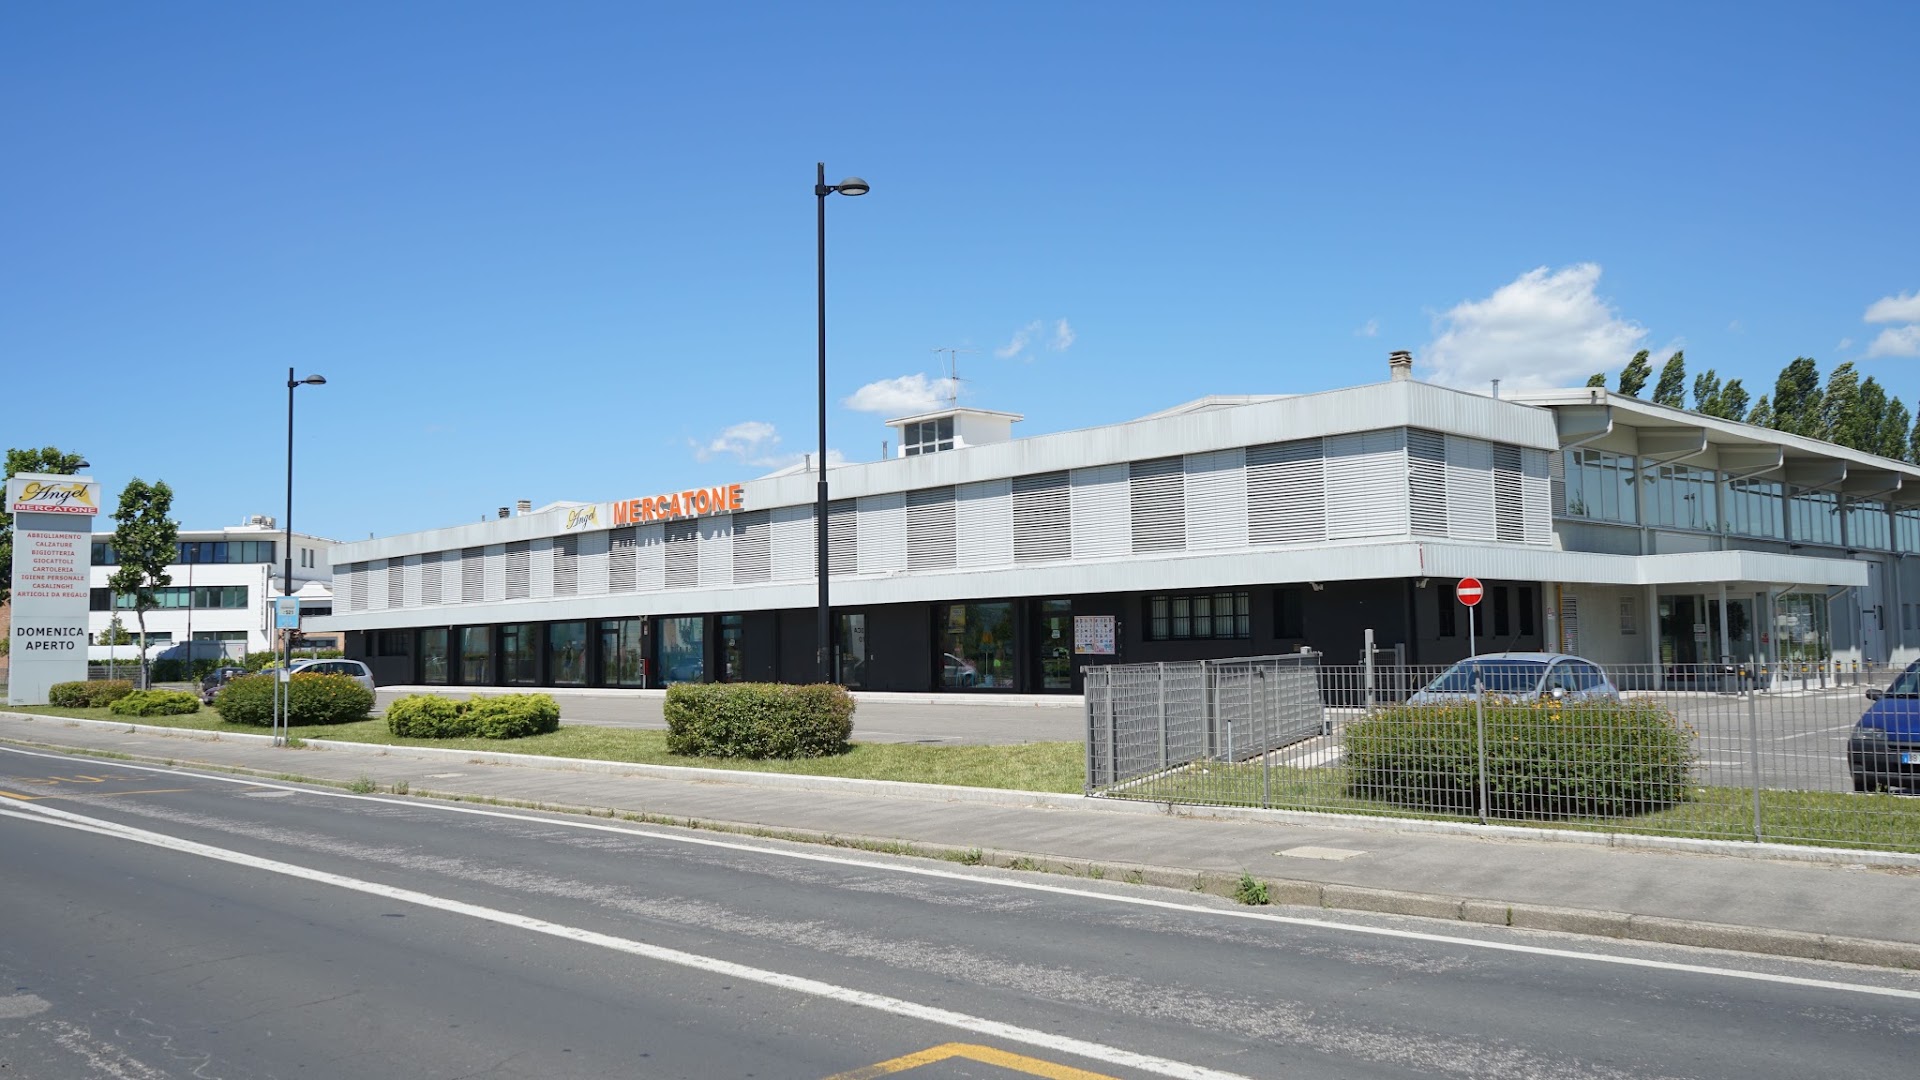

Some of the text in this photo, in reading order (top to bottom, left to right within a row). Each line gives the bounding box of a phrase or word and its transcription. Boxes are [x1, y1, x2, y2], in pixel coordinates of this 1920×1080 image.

[19, 482, 88, 505] Angel
[15, 504, 96, 513] MERCATONE
[613, 484, 741, 525] MERCATONE
[566, 505, 596, 530] Angel
[17, 627, 84, 637] DOMENICA
[25, 641, 75, 650] APERTO
